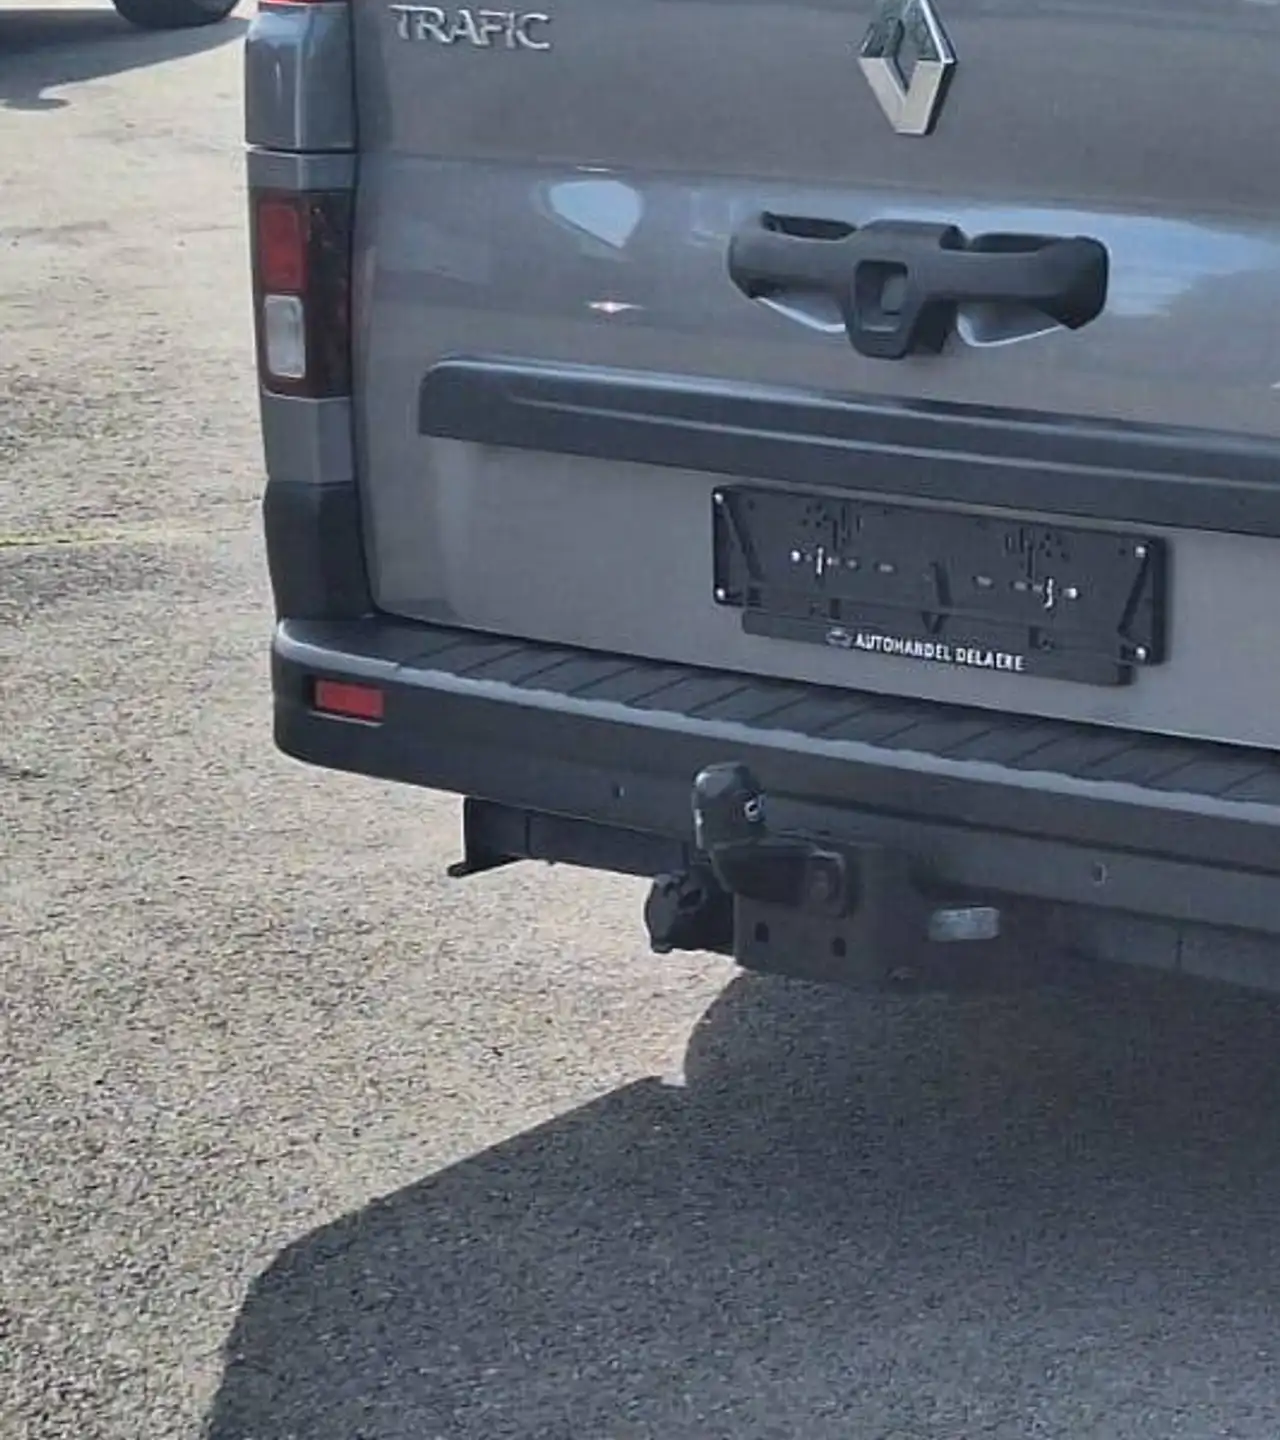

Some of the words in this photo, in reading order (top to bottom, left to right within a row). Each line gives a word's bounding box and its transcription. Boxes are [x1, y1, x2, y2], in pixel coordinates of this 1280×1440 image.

[388, 3, 551, 50] TRAFIC
[854, 632, 952, 661] AUTOHANDEL
[955, 646, 1026, 671] DELAERE
